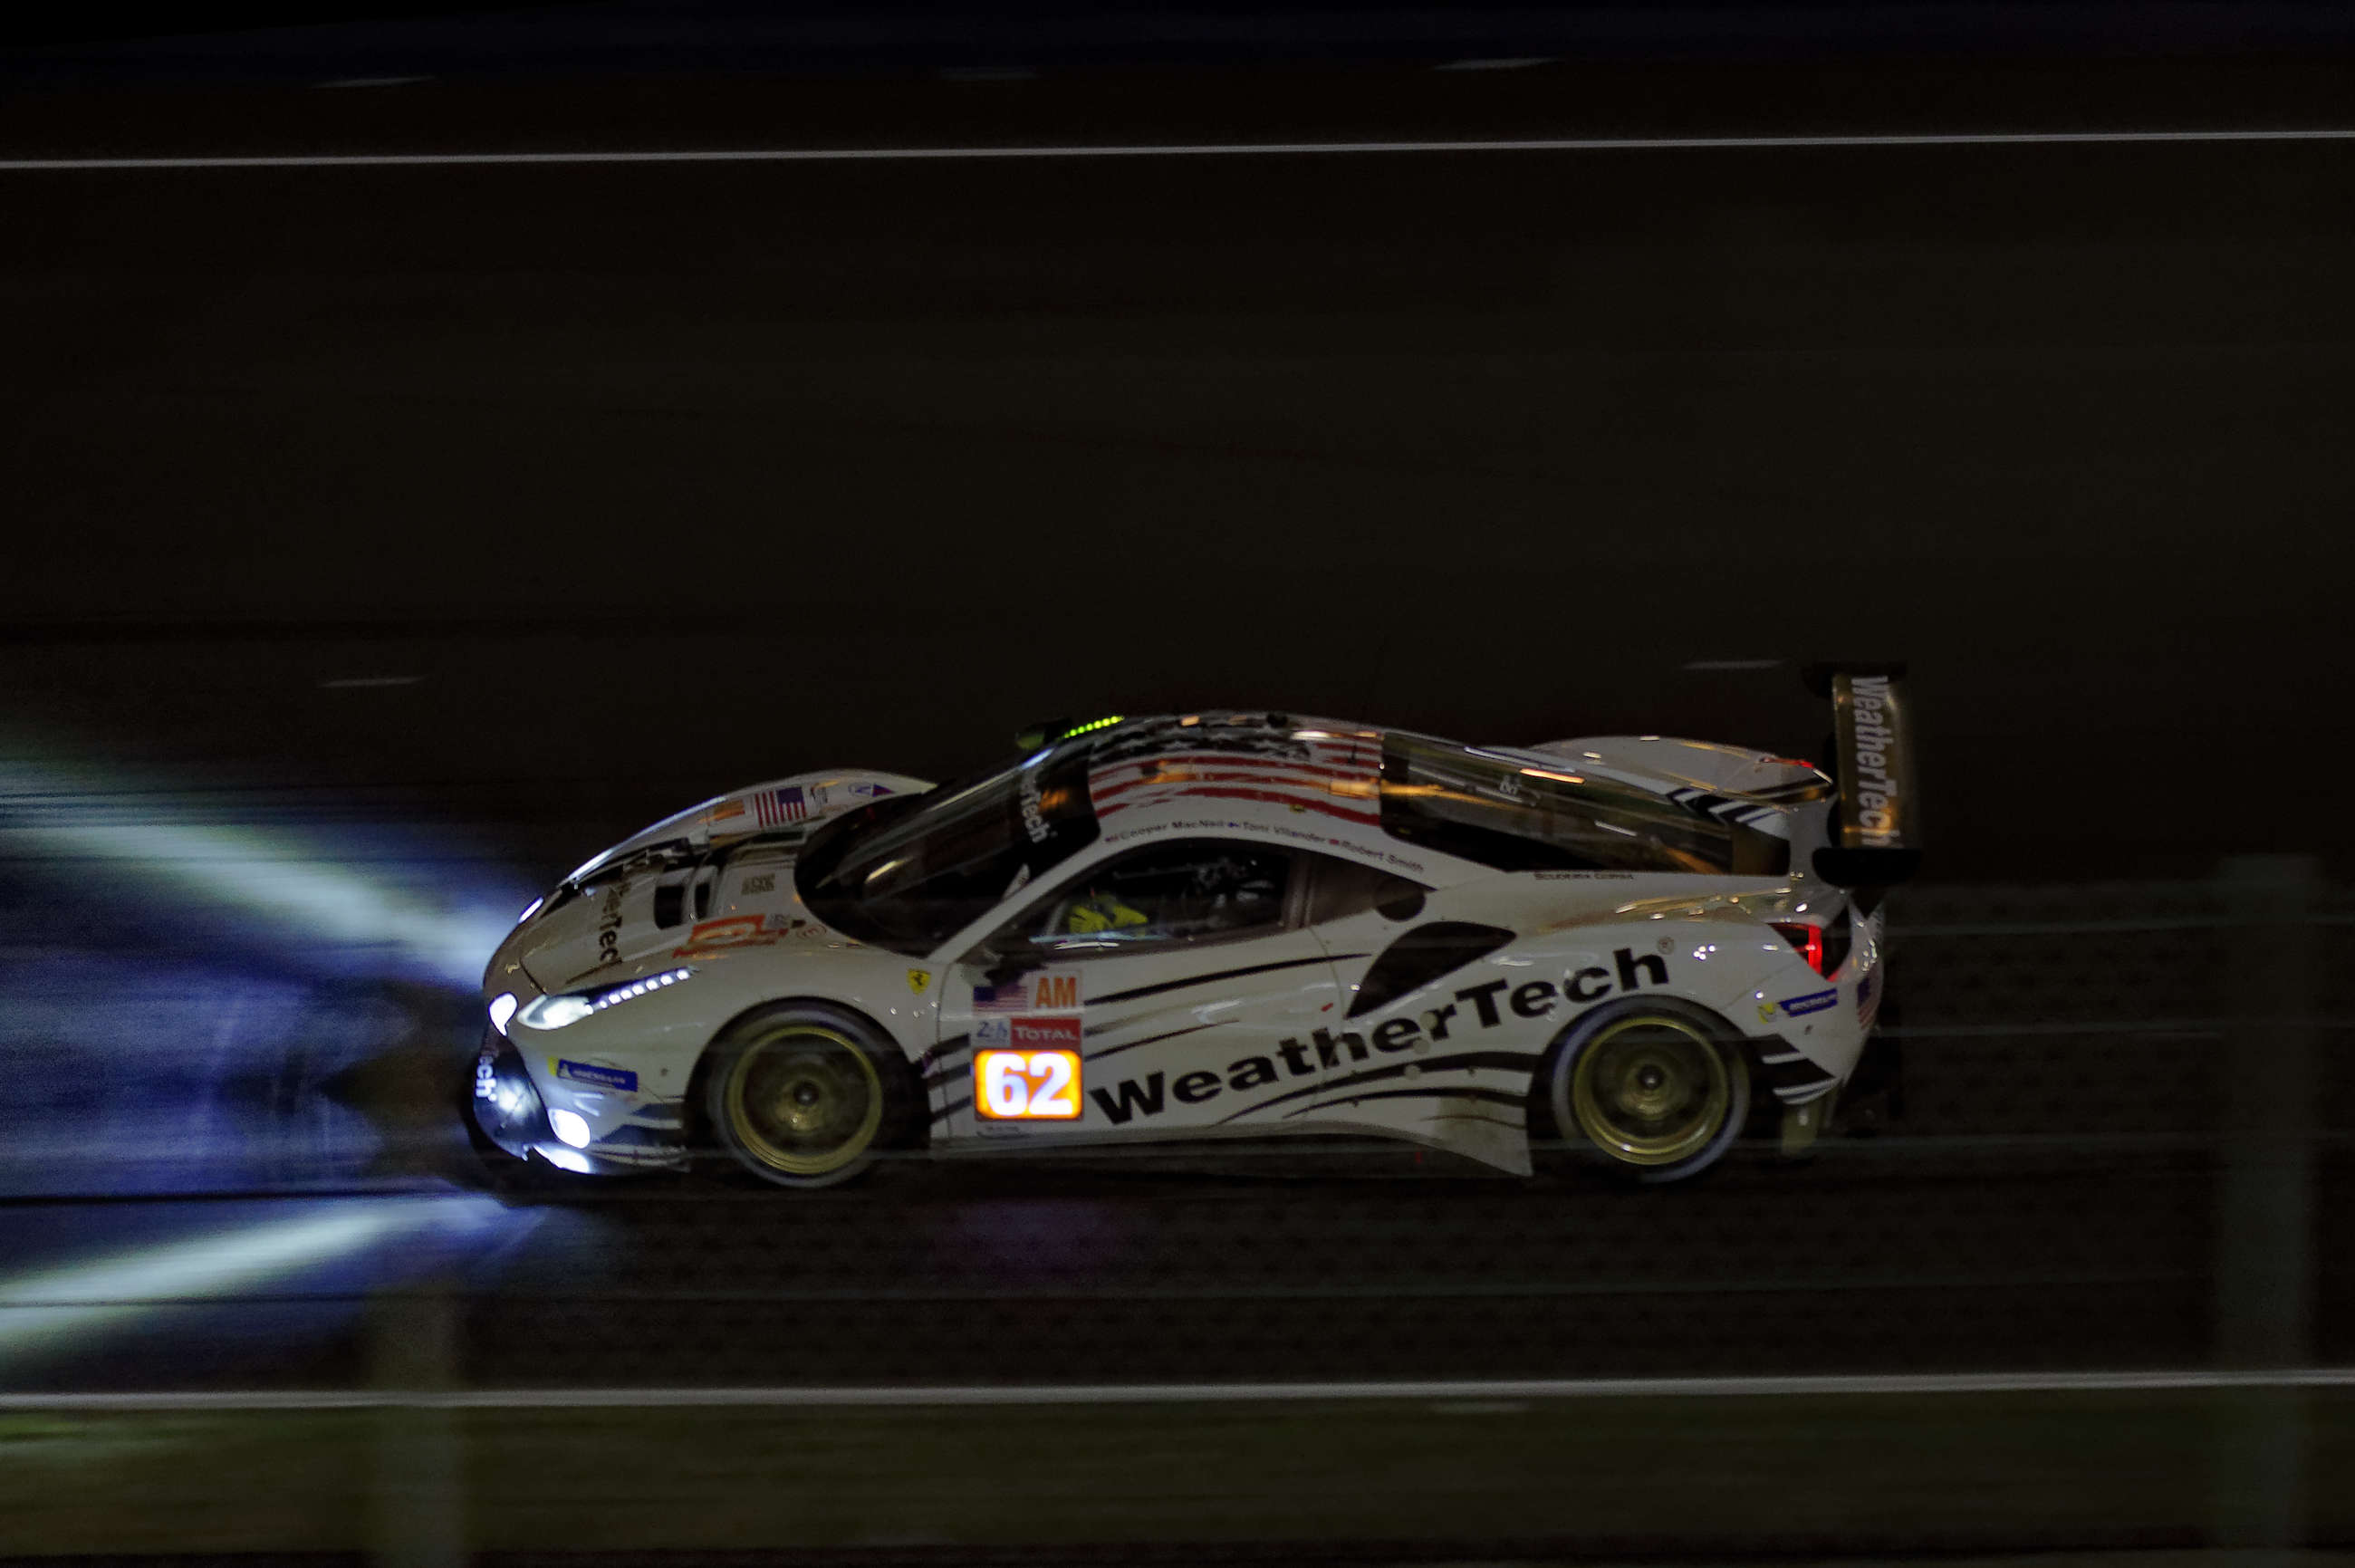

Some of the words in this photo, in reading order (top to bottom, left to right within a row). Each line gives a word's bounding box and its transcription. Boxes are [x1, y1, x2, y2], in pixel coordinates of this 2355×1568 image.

[1850, 675, 1901, 848] WeatherTech
[1035, 976, 1076, 1007] AM
[1014, 1025, 1078, 1041] TOTAL
[1090, 948, 1668, 1125] WeatherTech
[985, 1051, 1074, 1119] 62
